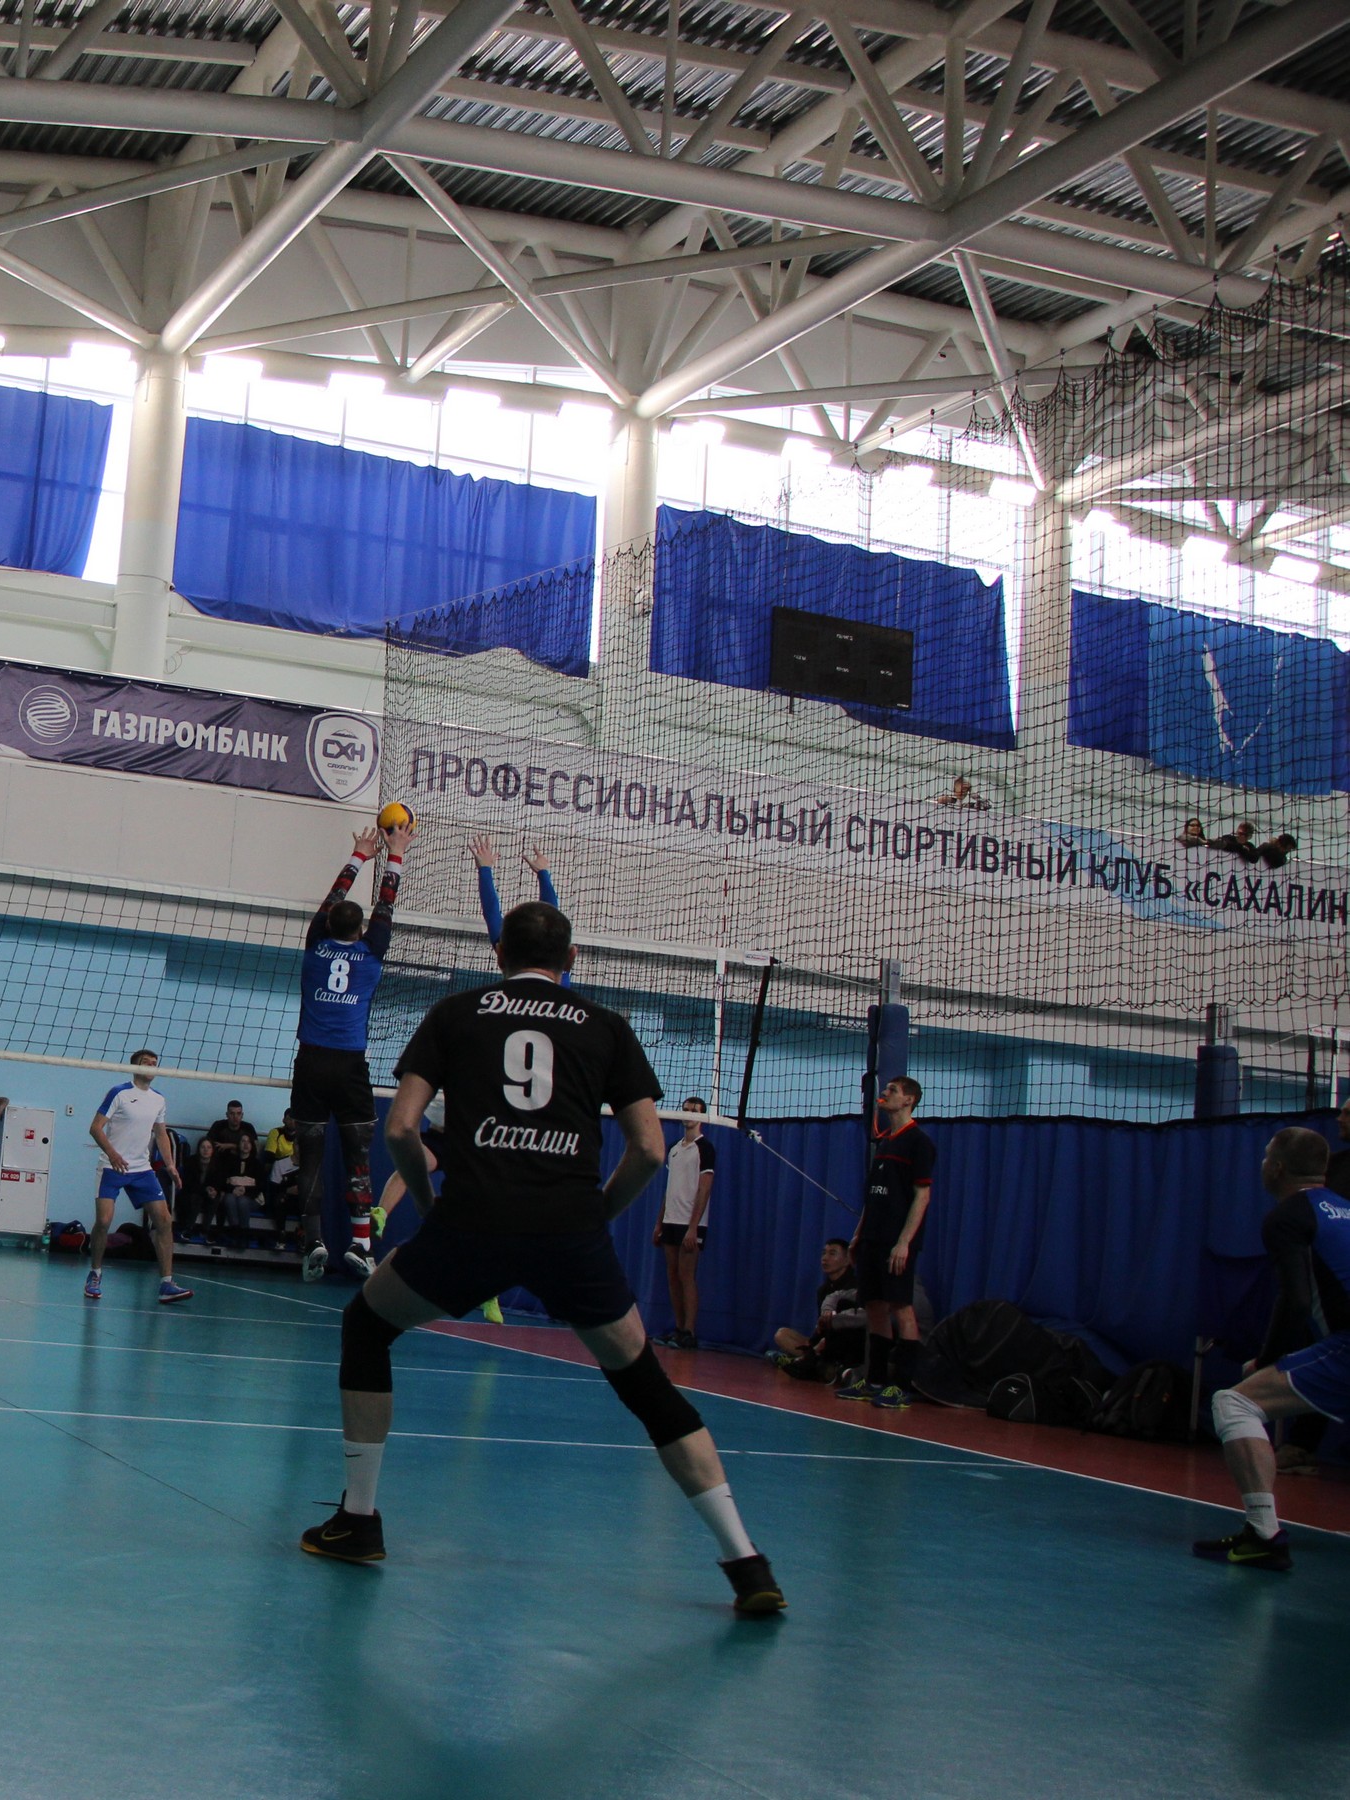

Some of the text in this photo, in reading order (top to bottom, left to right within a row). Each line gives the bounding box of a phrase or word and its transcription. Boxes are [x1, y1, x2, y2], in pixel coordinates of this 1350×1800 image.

[90, 708, 289, 764] ГАЗПРОМБАНК
[411, 748, 1348, 926] ПРОФЕССИОНАЛЬНЫЙ СПОРТИВНЫЙ КЛУБ «САХАЛИН
[327, 958, 351, 994] 8
[477, 989, 589, 1024] Динамо
[502, 1029, 555, 1111] 9
[474, 1115, 581, 1157] Сахалин
